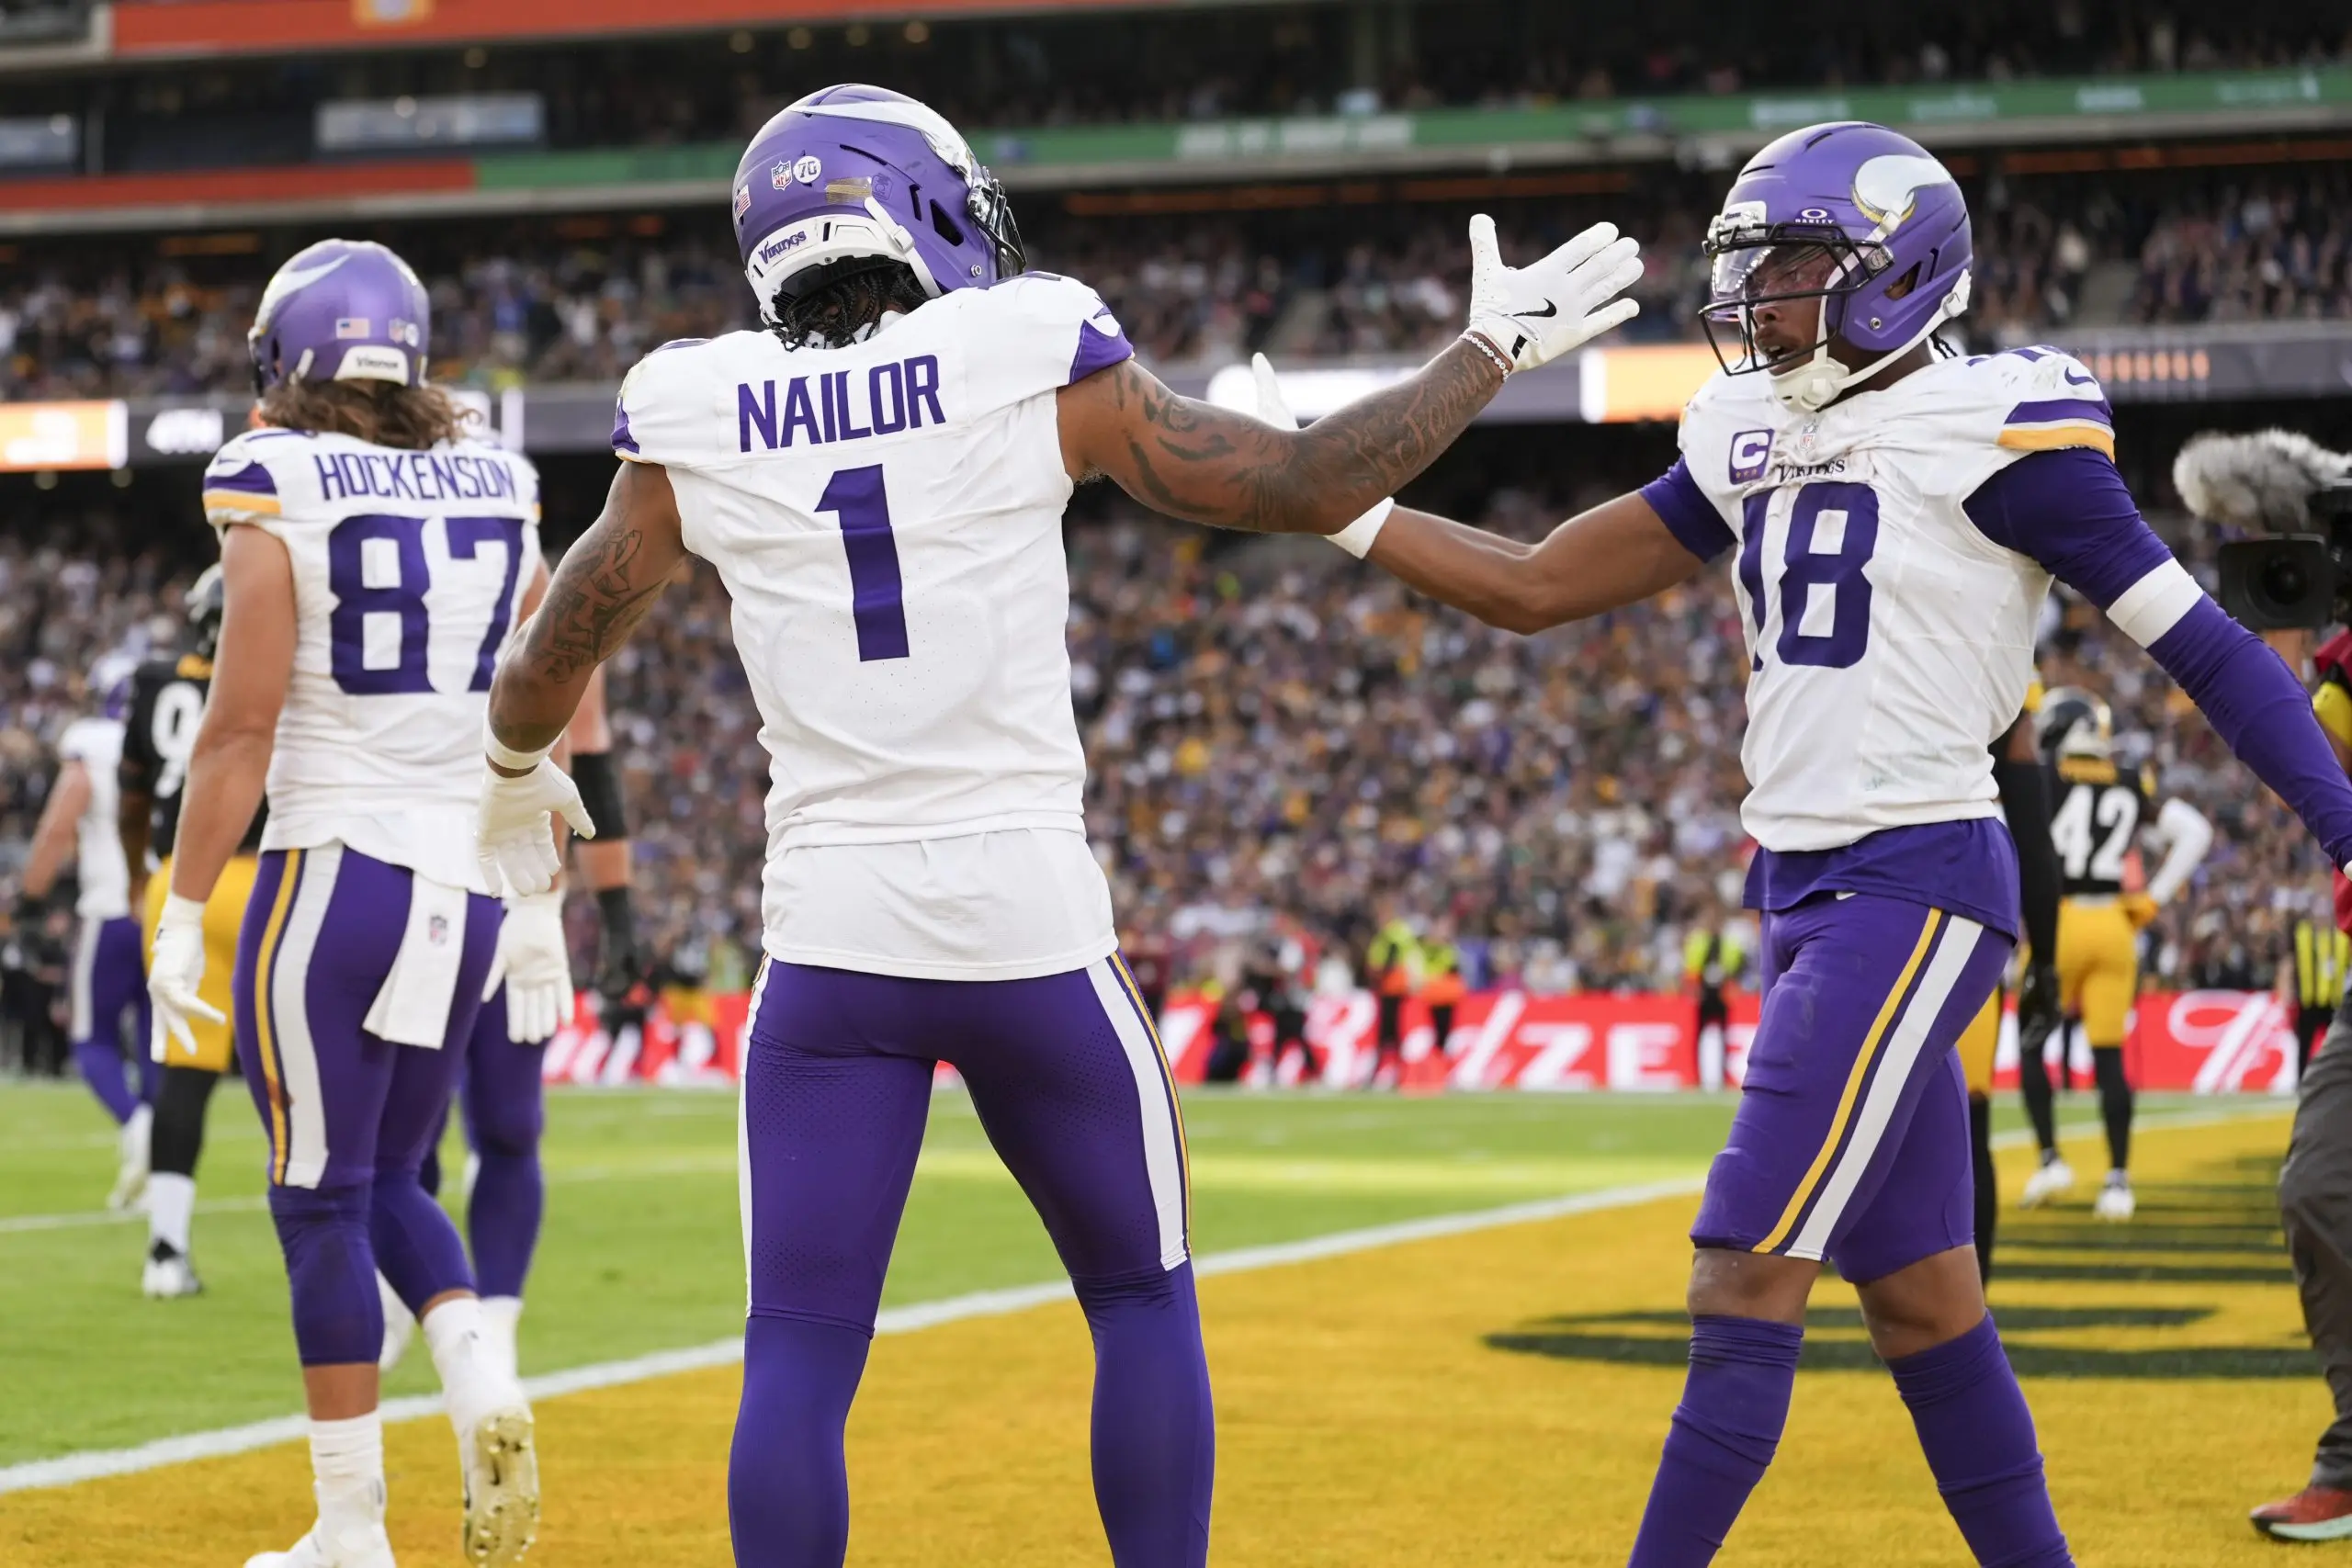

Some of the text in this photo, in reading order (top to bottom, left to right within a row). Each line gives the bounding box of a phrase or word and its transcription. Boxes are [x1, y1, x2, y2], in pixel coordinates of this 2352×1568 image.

[738, 354, 946, 452] NAILOR
[1731, 431, 1770, 469] C
[313, 452, 517, 503] HOCKENSON
[329, 514, 526, 695] 87
[814, 463, 910, 661] 1
[1739, 481, 1879, 671] 18
[152, 682, 206, 798] 9
[2049, 784, 2140, 880] 42
